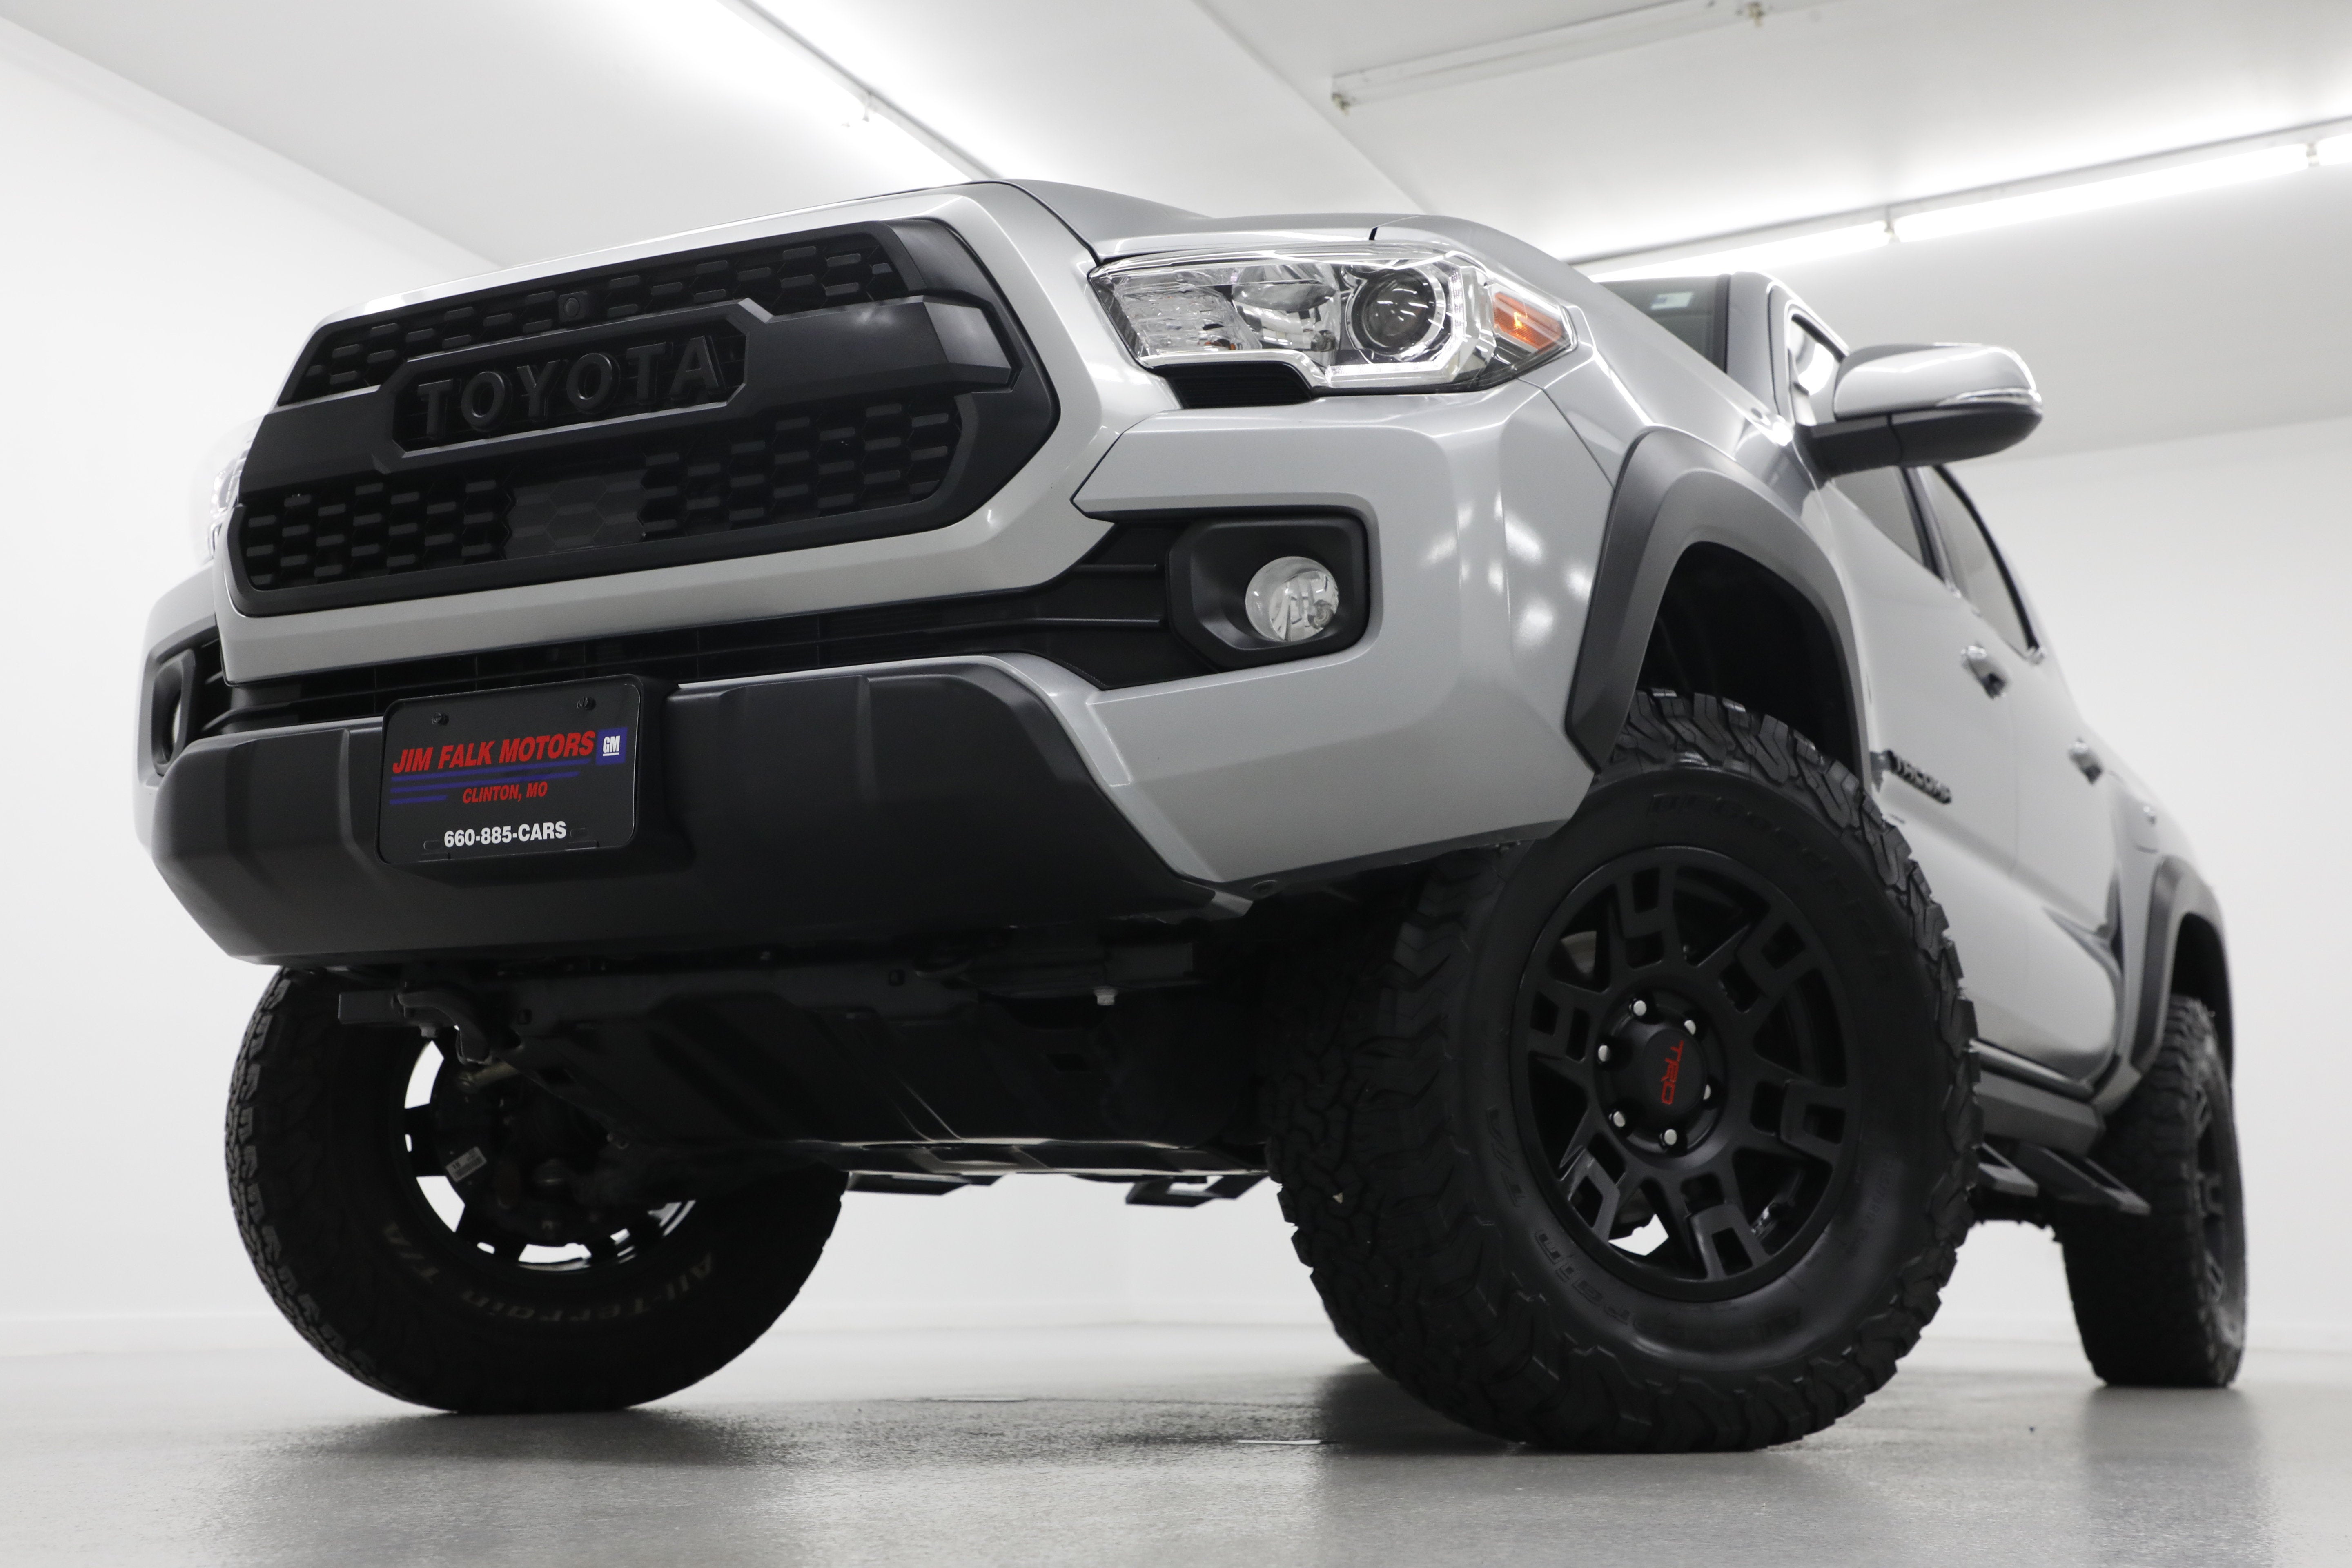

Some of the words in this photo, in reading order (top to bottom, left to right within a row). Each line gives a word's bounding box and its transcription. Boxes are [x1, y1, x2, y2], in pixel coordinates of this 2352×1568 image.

[416, 335, 726, 441] TOYOTA
[392, 747, 434, 774] JIM
[437, 740, 495, 770] FALK
[499, 730, 596, 764] MOTORS
[602, 735, 621, 753] GM
[462, 784, 521, 804] CLINTON,
[526, 781, 548, 798] MO
[444, 820, 566, 848] 660-885-CARS
[1660, 1040, 1684, 1105] TRD
[384, 1222, 441, 1284] T/A
[460, 1251, 713, 1322] All-Terrain
